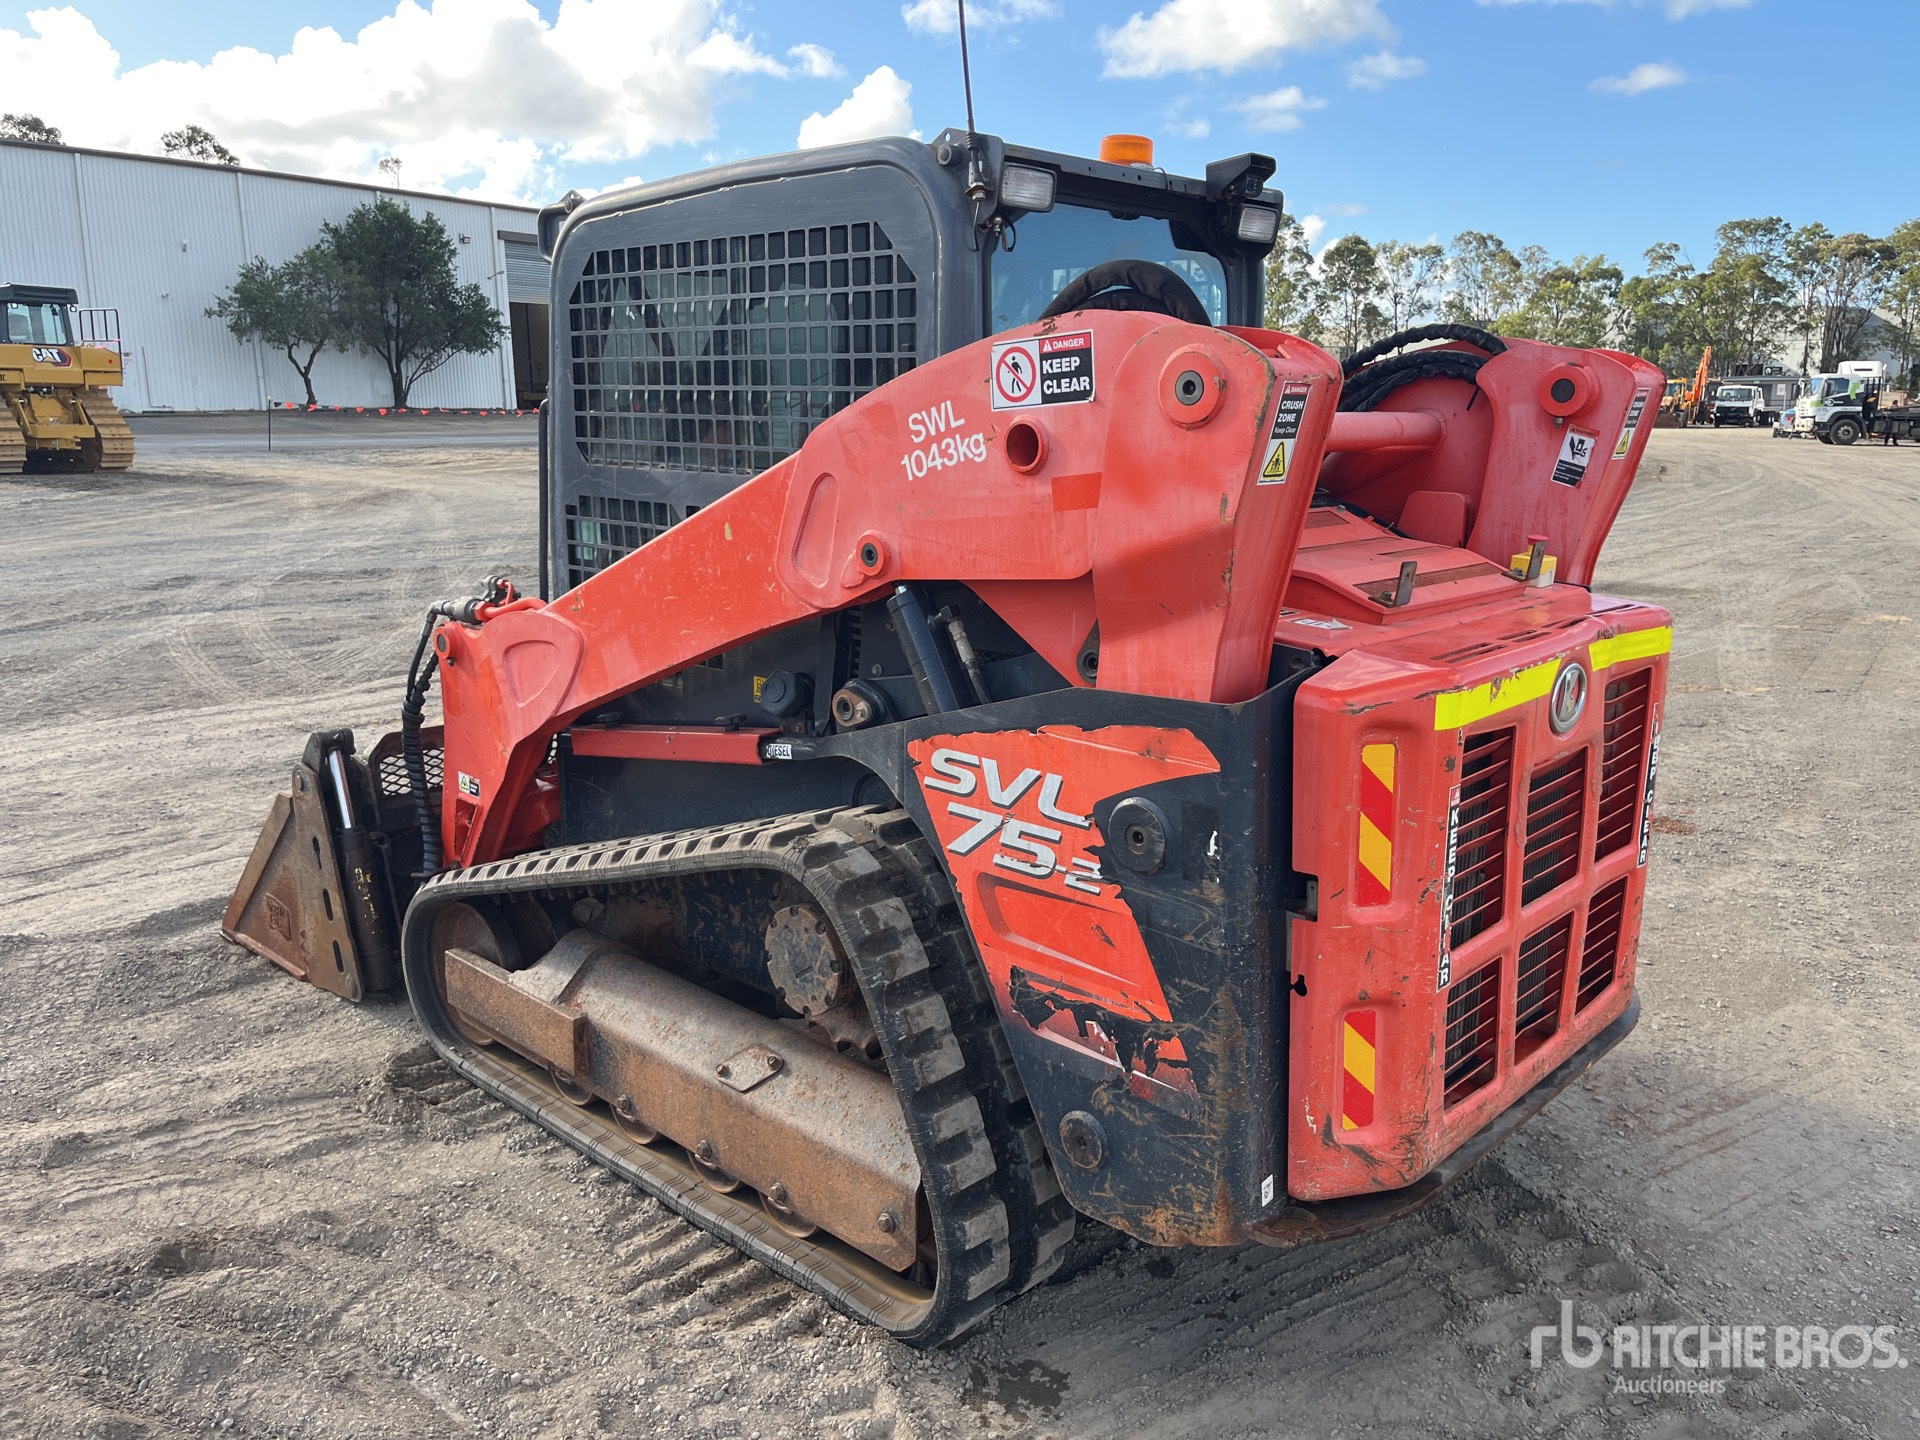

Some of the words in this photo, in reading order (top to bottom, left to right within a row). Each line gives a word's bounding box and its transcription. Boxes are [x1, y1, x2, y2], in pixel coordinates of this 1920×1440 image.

[1053, 338, 1084, 349] DANGER
[32, 347, 61, 363] CAT
[1042, 357, 1080, 374] KEEP
[1043, 377, 1090, 395] CLEAR
[1281, 401, 1304, 410] CRUSH
[908, 400, 965, 443] SWL
[1277, 413, 1297, 422] ZONE
[901, 433, 987, 481] 1043kg
[923, 748, 1096, 830] SVL
[1447, 807, 1460, 882] KEEP
